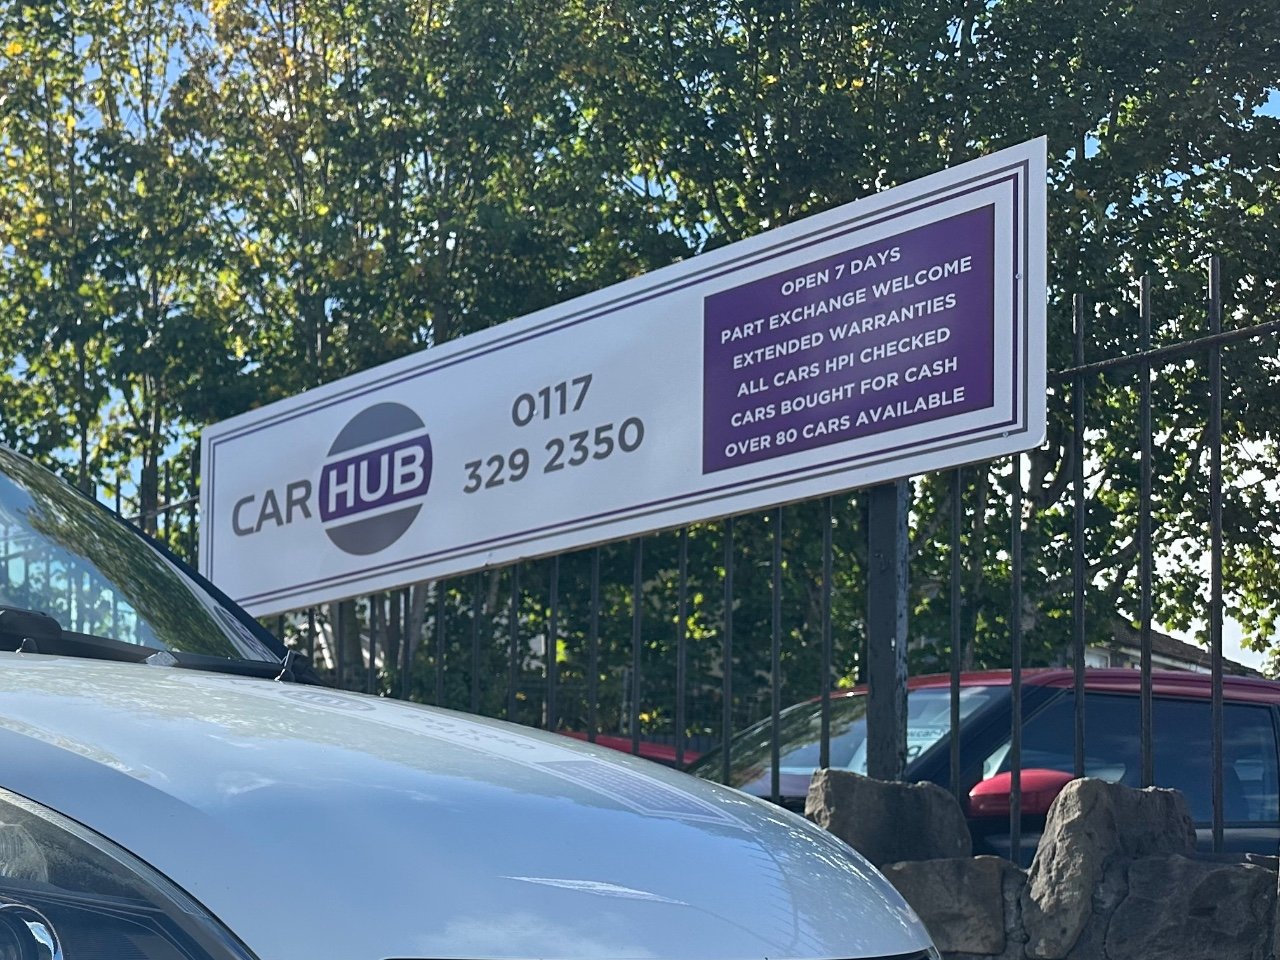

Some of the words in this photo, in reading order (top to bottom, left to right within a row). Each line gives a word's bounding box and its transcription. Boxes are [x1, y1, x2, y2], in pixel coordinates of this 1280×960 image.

[720, 319, 765, 345] PART
[769, 291, 867, 331] EXCHANGE
[871, 255, 973, 299] WELCOME
[781, 269, 829, 297] OPEN
[834, 263, 845, 280] 7
[850, 246, 902, 276] DAYS
[733, 332, 824, 370] EXTENDED
[829, 293, 957, 342] WARRANTIES
[737, 378, 769, 398] ALL
[773, 363, 820, 387] CARS
[825, 354, 855, 374] HPI
[860, 327, 952, 365] CHECKED
[511, 373, 593, 427] 0117
[724, 436, 771, 458] OVER
[775, 428, 798, 445] 80
[802, 416, 851, 439] CARS
[856, 386, 966, 427] AVAILABLE
[730, 404, 776, 428] CARS
[781, 384, 855, 416] BOUGHT
[860, 372, 899, 393] FOR
[904, 356, 958, 383] CASH
[231, 479, 313, 537] CAR
[328, 445, 426, 513] HUB
[462, 447, 530, 494] 329
[543, 416, 645, 474] 2350
